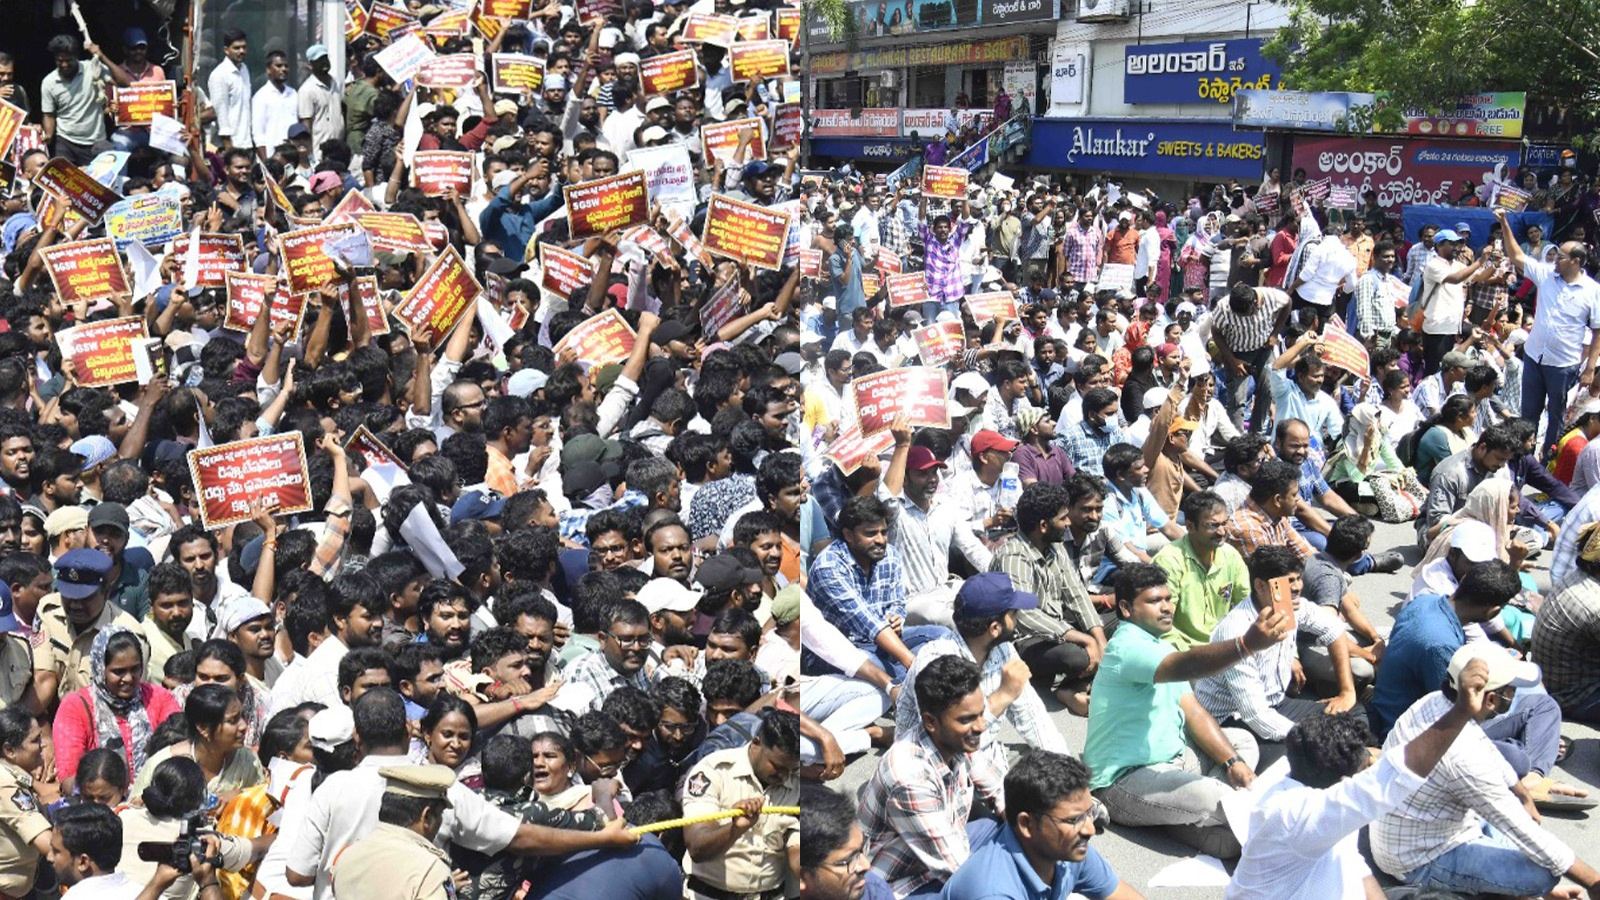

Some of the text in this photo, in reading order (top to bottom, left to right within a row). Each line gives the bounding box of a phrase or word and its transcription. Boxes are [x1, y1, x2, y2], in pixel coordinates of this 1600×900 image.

[1127, 43, 1245, 74] అలంకార్ ఇన్
[1056, 64, 1076, 77] బార్
[1475, 124, 1504, 136] FREE
[1067, 126, 1149, 163] Alankar
[1157, 141, 1261, 160] SWEETS & BAKERS
[1318, 145, 1403, 176] అలంకార్
[1441, 152, 1450, 161] 24
[1378, 176, 1452, 208] హోటల్
[573, 198, 599, 210] SGSW
